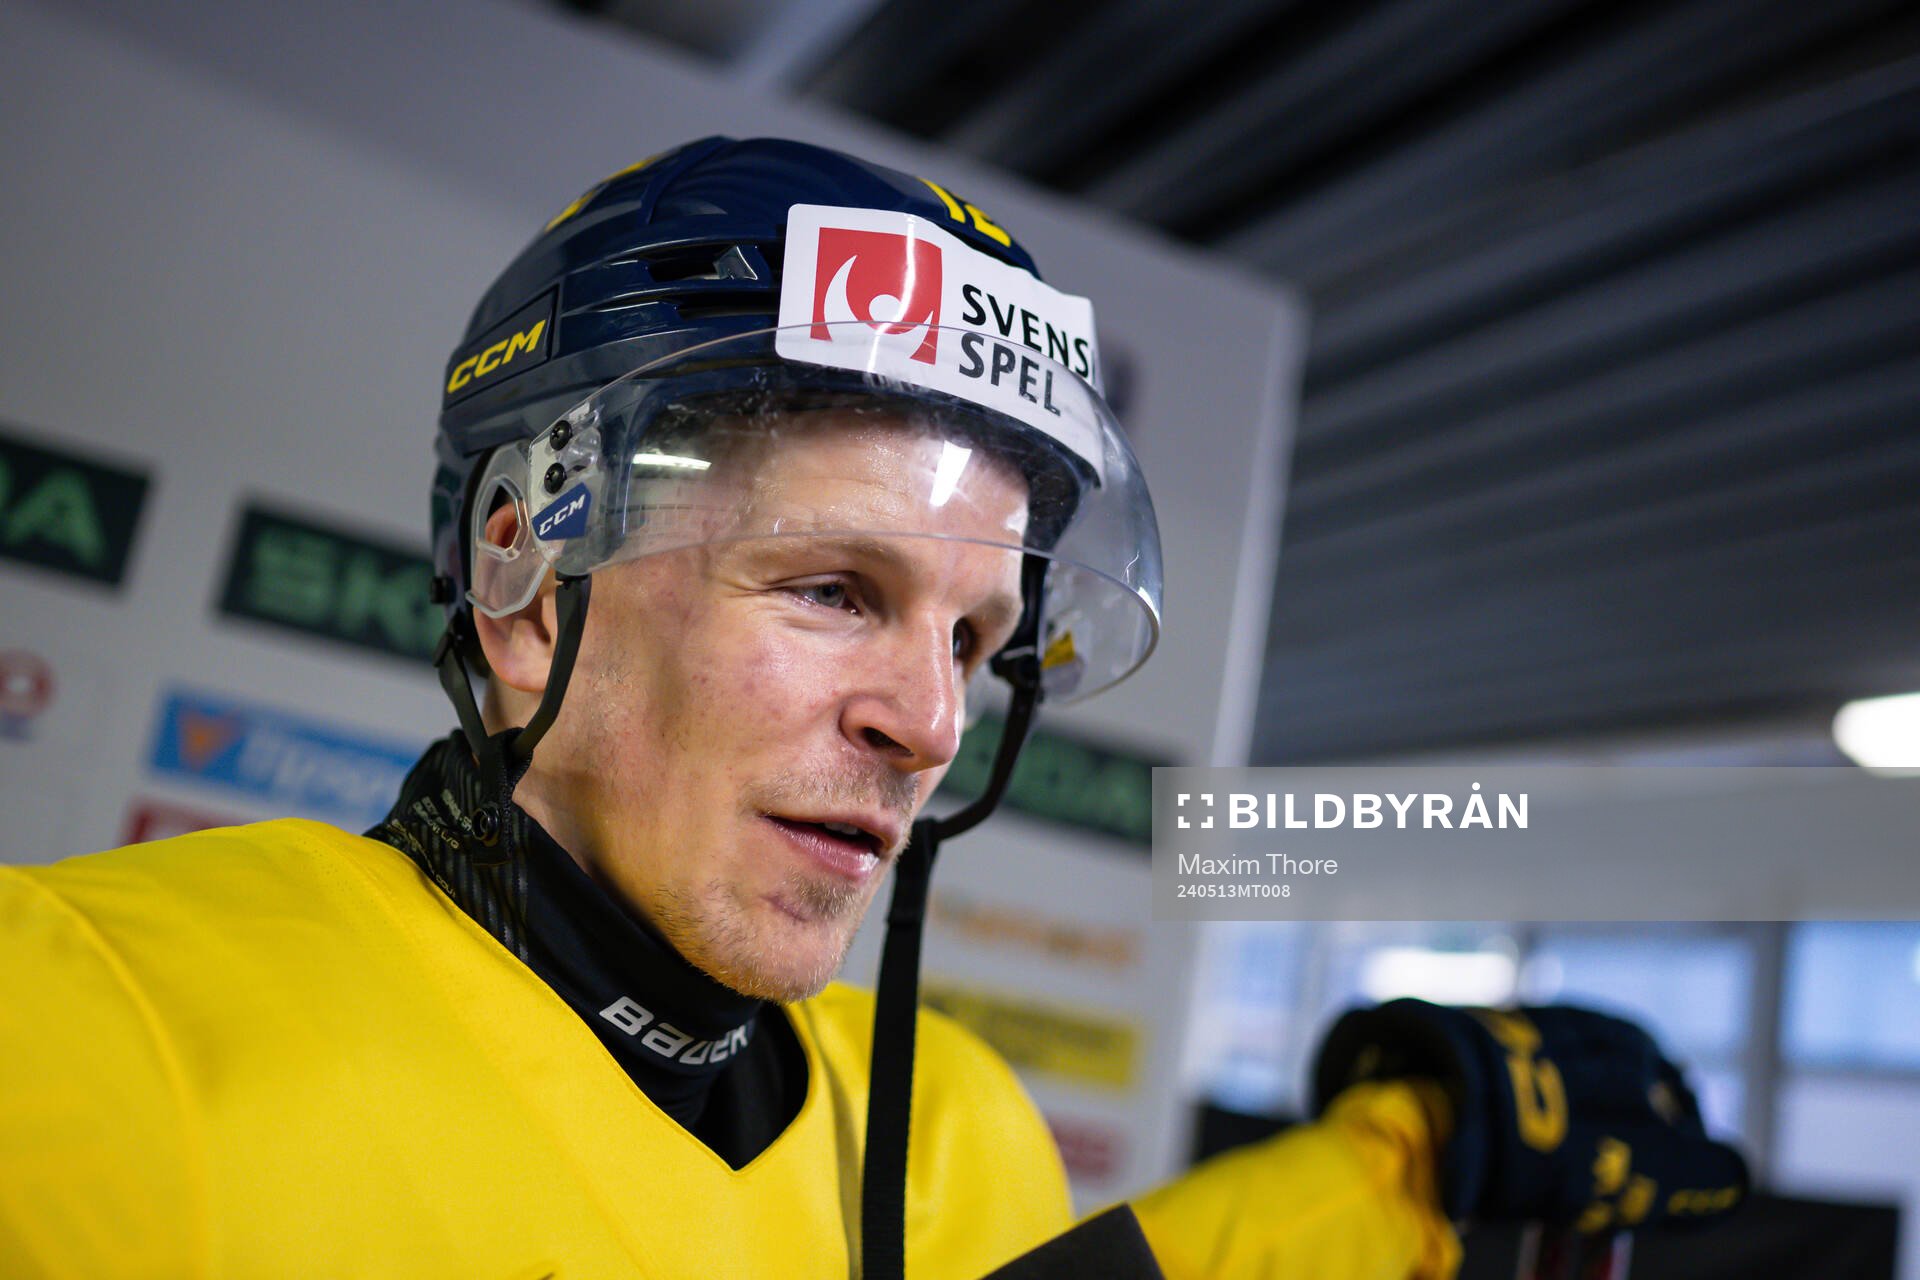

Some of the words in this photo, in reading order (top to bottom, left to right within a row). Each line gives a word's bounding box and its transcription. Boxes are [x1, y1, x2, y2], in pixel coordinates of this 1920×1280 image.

[448, 318, 547, 394] CCM
[958, 332, 1061, 417] SPEL
[961, 283, 1096, 386] SVENS
[539, 493, 586, 537] CCM
